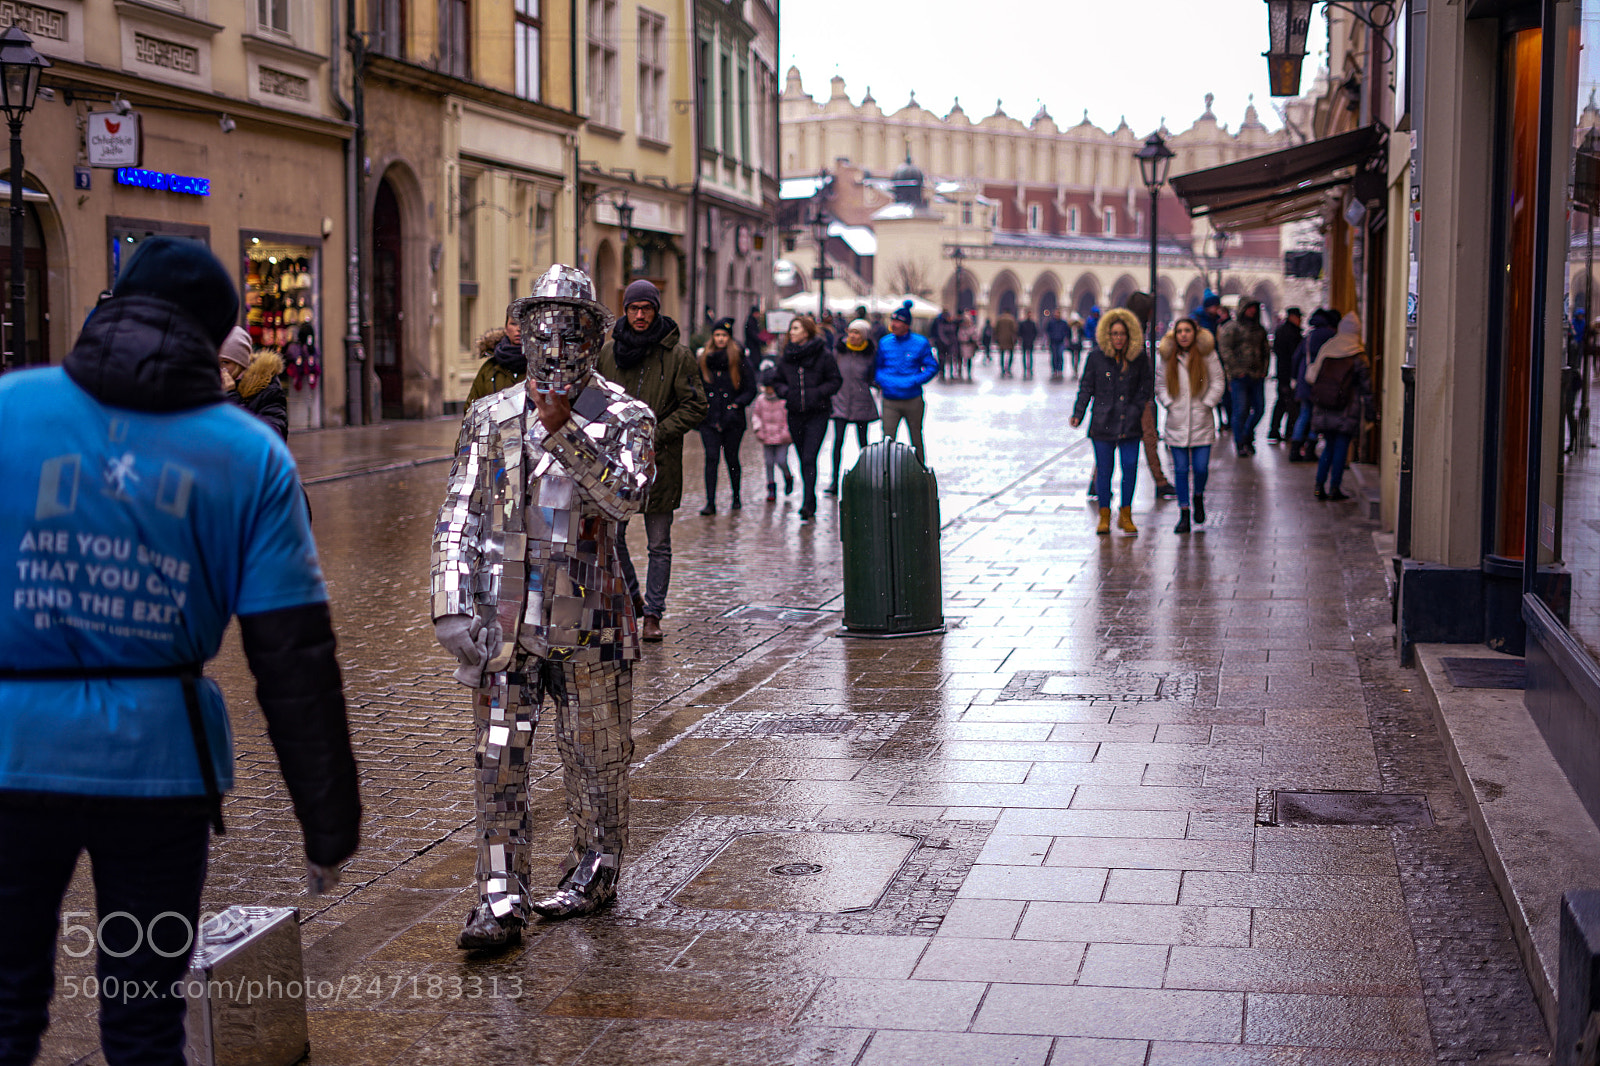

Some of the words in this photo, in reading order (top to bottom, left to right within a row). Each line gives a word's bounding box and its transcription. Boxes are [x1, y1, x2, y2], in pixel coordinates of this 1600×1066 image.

[1292, 17, 1307, 35] 10
[19, 530, 69, 554] ARE
[77, 532, 131, 561] YOU
[16, 559, 79, 583] THAT
[85, 564, 140, 591] YOU
[14, 588, 72, 610] FIND
[79, 591, 125, 619] THE
